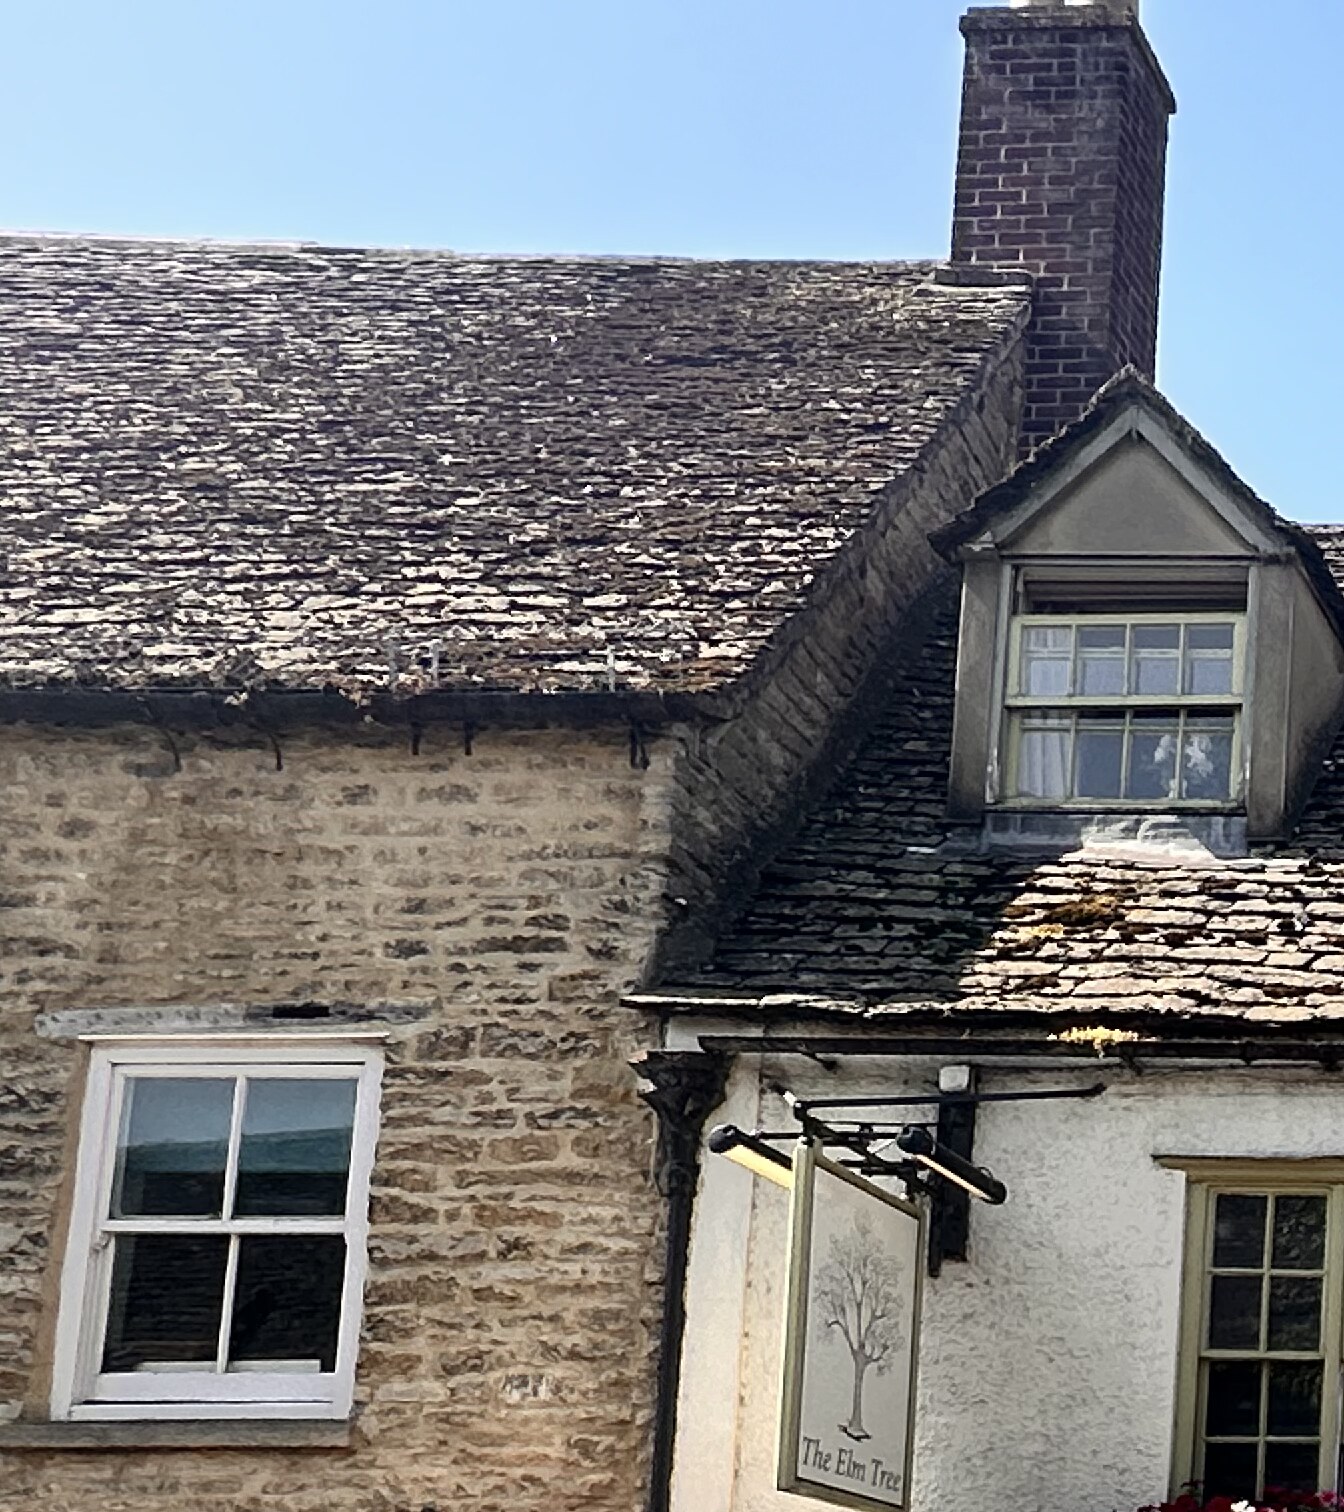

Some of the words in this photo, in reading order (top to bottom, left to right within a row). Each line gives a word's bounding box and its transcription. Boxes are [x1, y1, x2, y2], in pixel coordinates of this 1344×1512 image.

[802, 1436, 832, 1472] The
[834, 1447, 866, 1482] Elm
[871, 1458, 902, 1492] Tree
